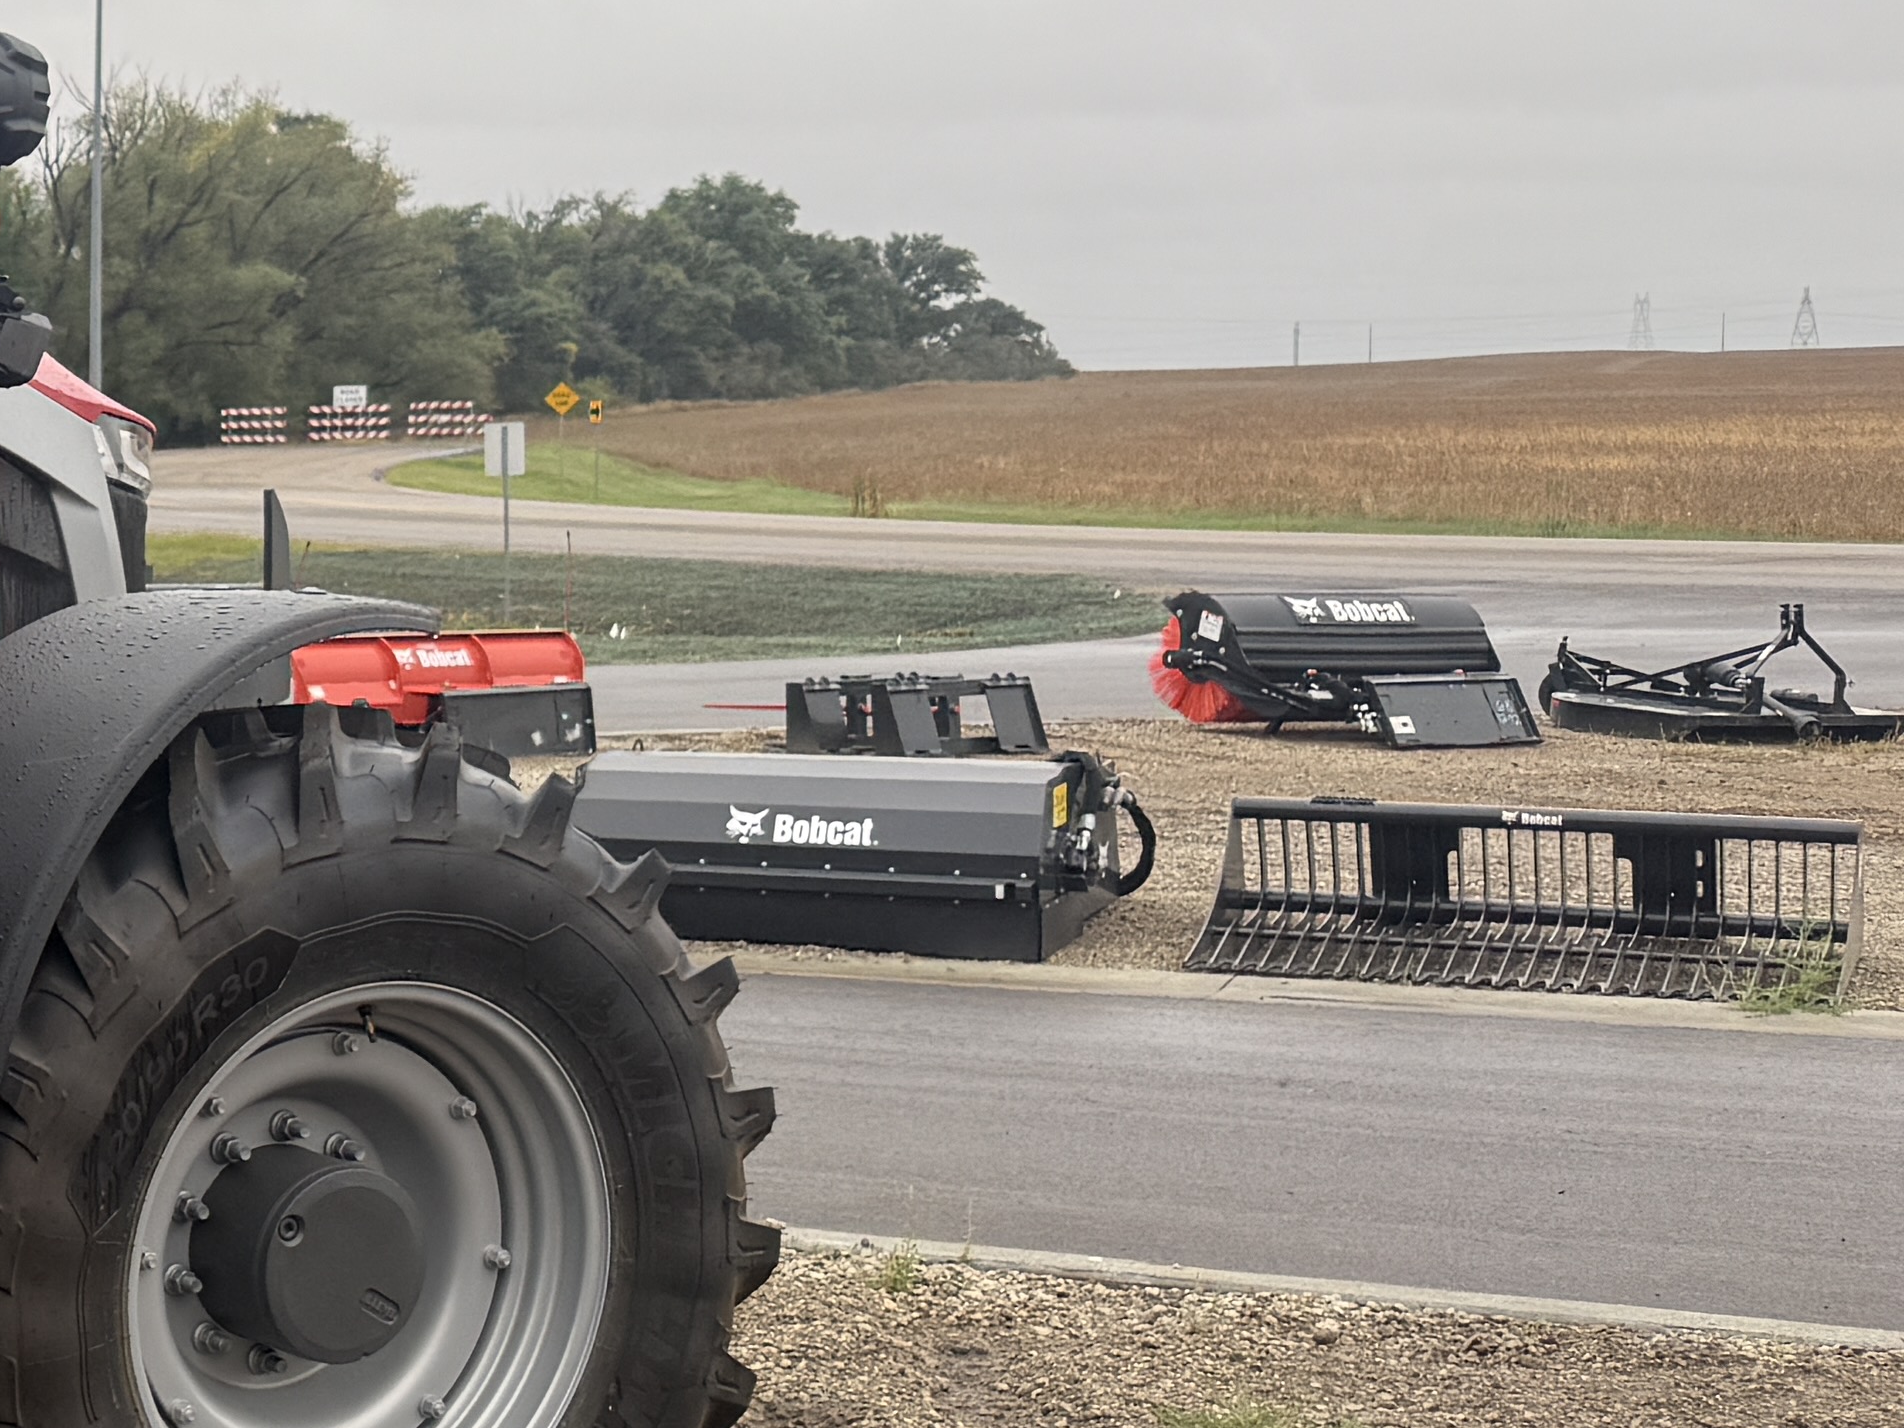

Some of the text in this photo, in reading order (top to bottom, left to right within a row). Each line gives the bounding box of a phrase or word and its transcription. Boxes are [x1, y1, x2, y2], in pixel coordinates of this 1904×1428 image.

[1324, 599, 1410, 622] Bobcat
[416, 650, 472, 668] Bobcat
[1520, 812, 1563, 827] Bobcat
[772, 813, 875, 847] Bobcat
